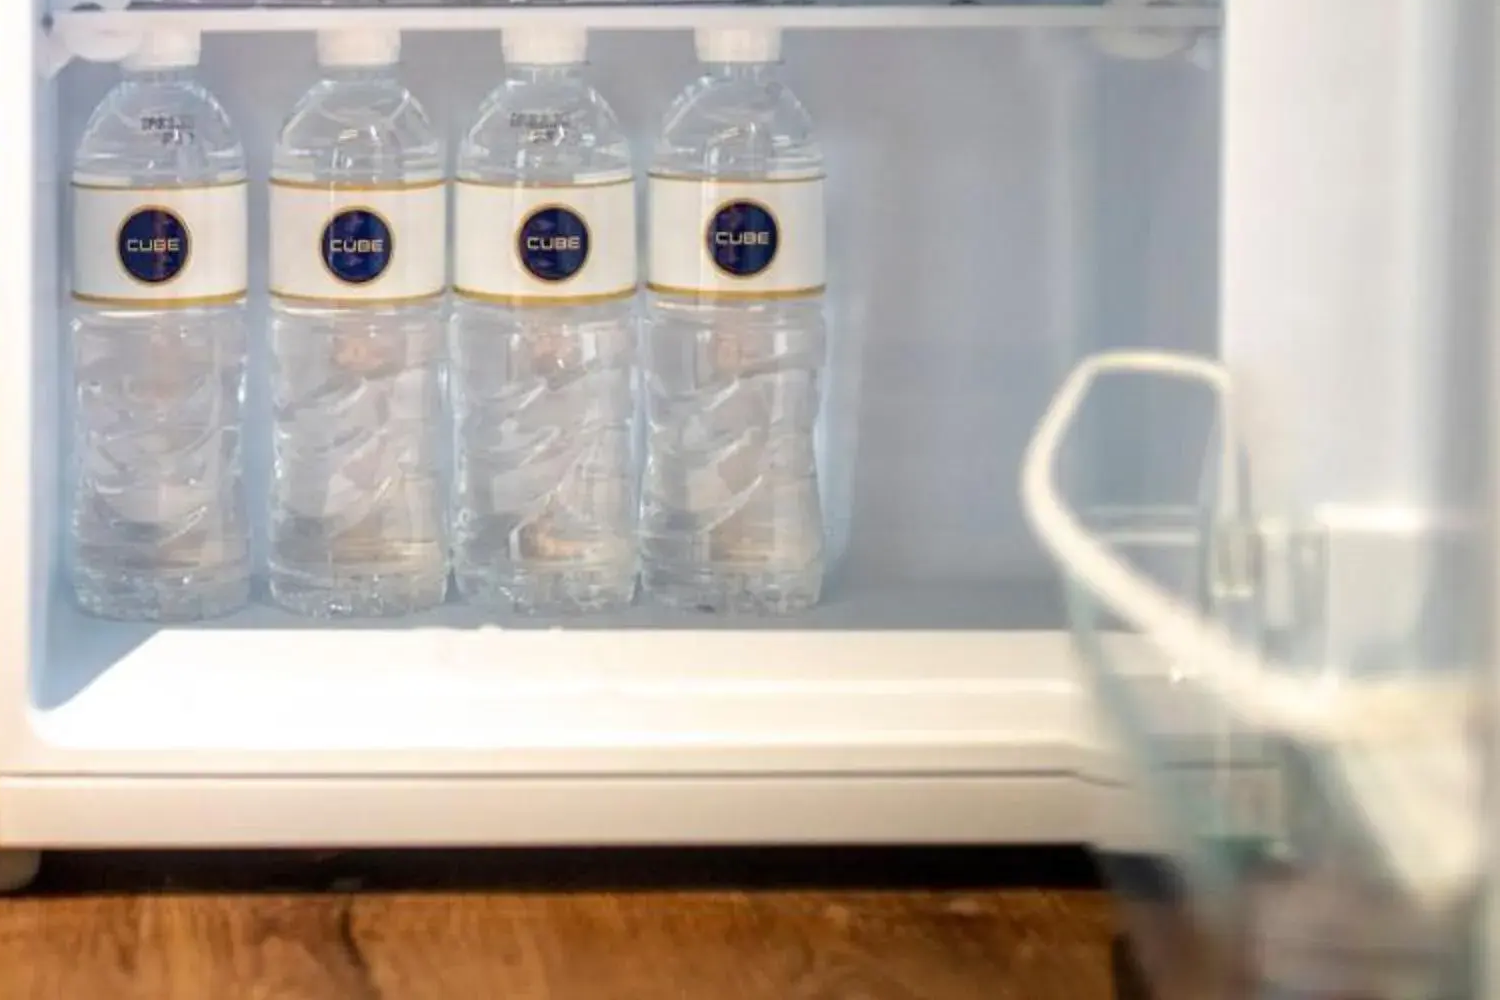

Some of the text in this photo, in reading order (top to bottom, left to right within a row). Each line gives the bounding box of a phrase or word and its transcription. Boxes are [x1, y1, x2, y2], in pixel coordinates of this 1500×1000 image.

[127, 238, 181, 252] CUBE
[527, 236, 581, 250] CUBE
[715, 231, 770, 245] CUBE
[330, 238, 384, 253] CUBE
